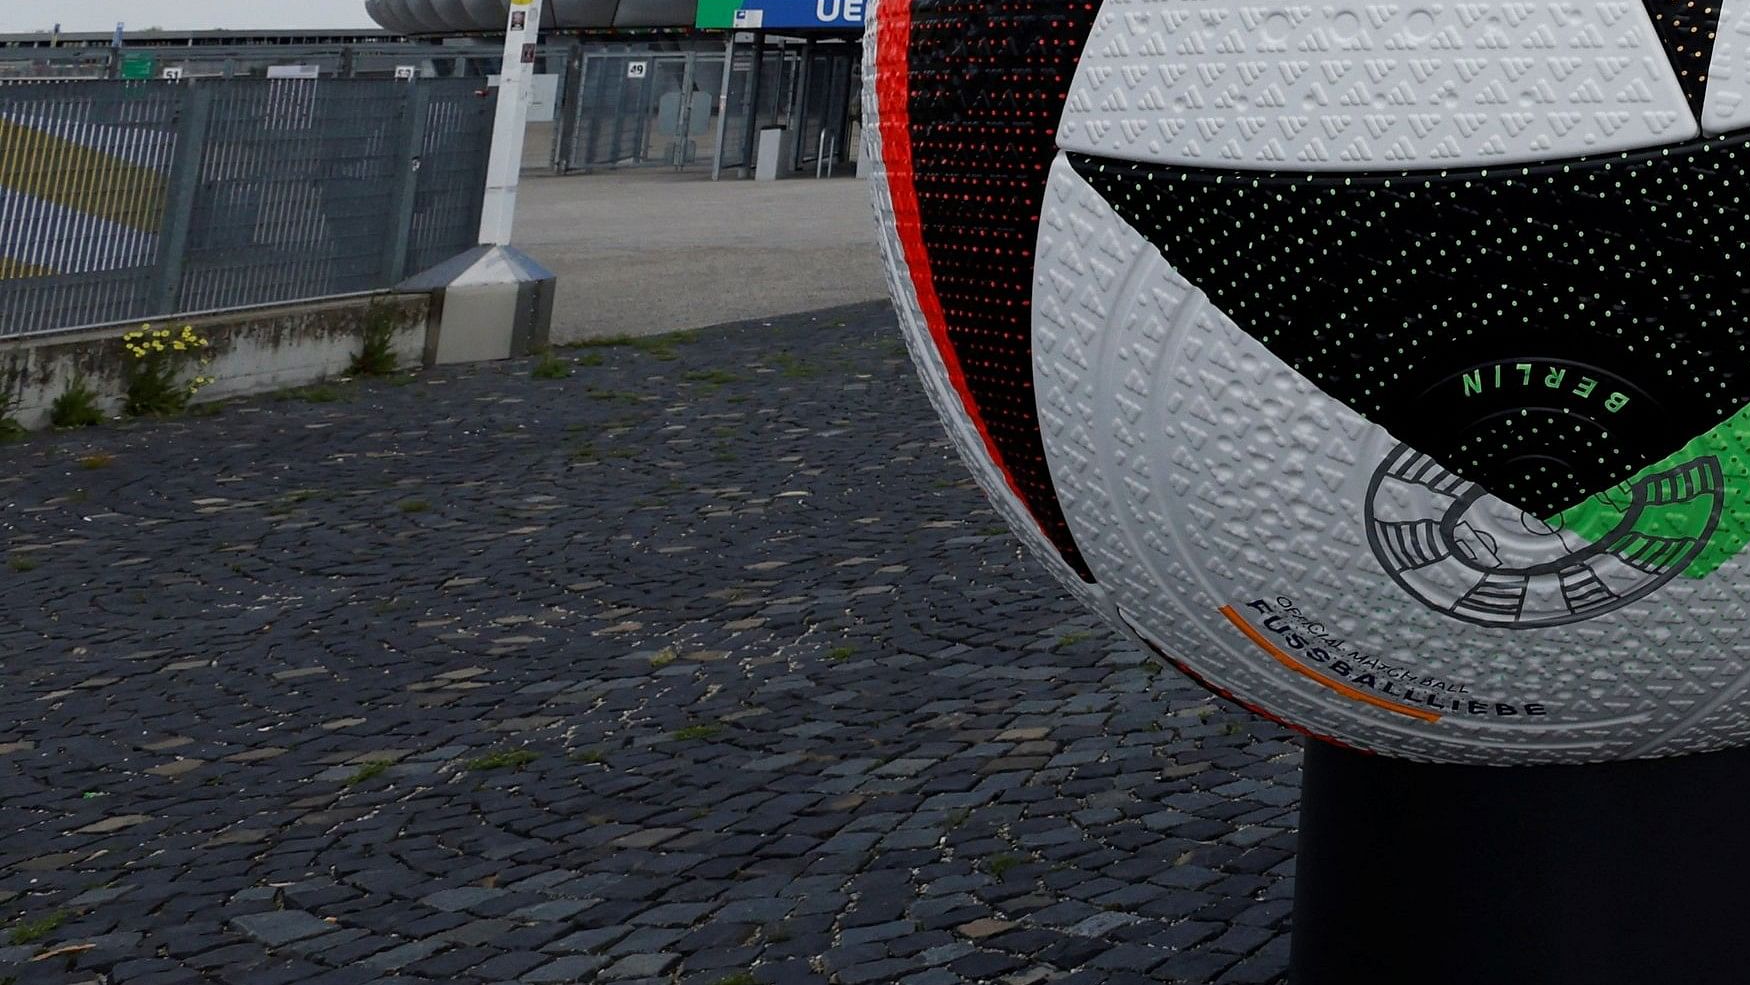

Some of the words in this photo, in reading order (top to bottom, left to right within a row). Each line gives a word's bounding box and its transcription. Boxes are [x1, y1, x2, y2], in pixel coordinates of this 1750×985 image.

[630, 64, 643, 75] 49
[1462, 363, 1630, 414] BERLIN
[1276, 595, 1345, 652] OFFICIAL
[1247, 598, 1547, 717] FUSSBALLLIEBE
